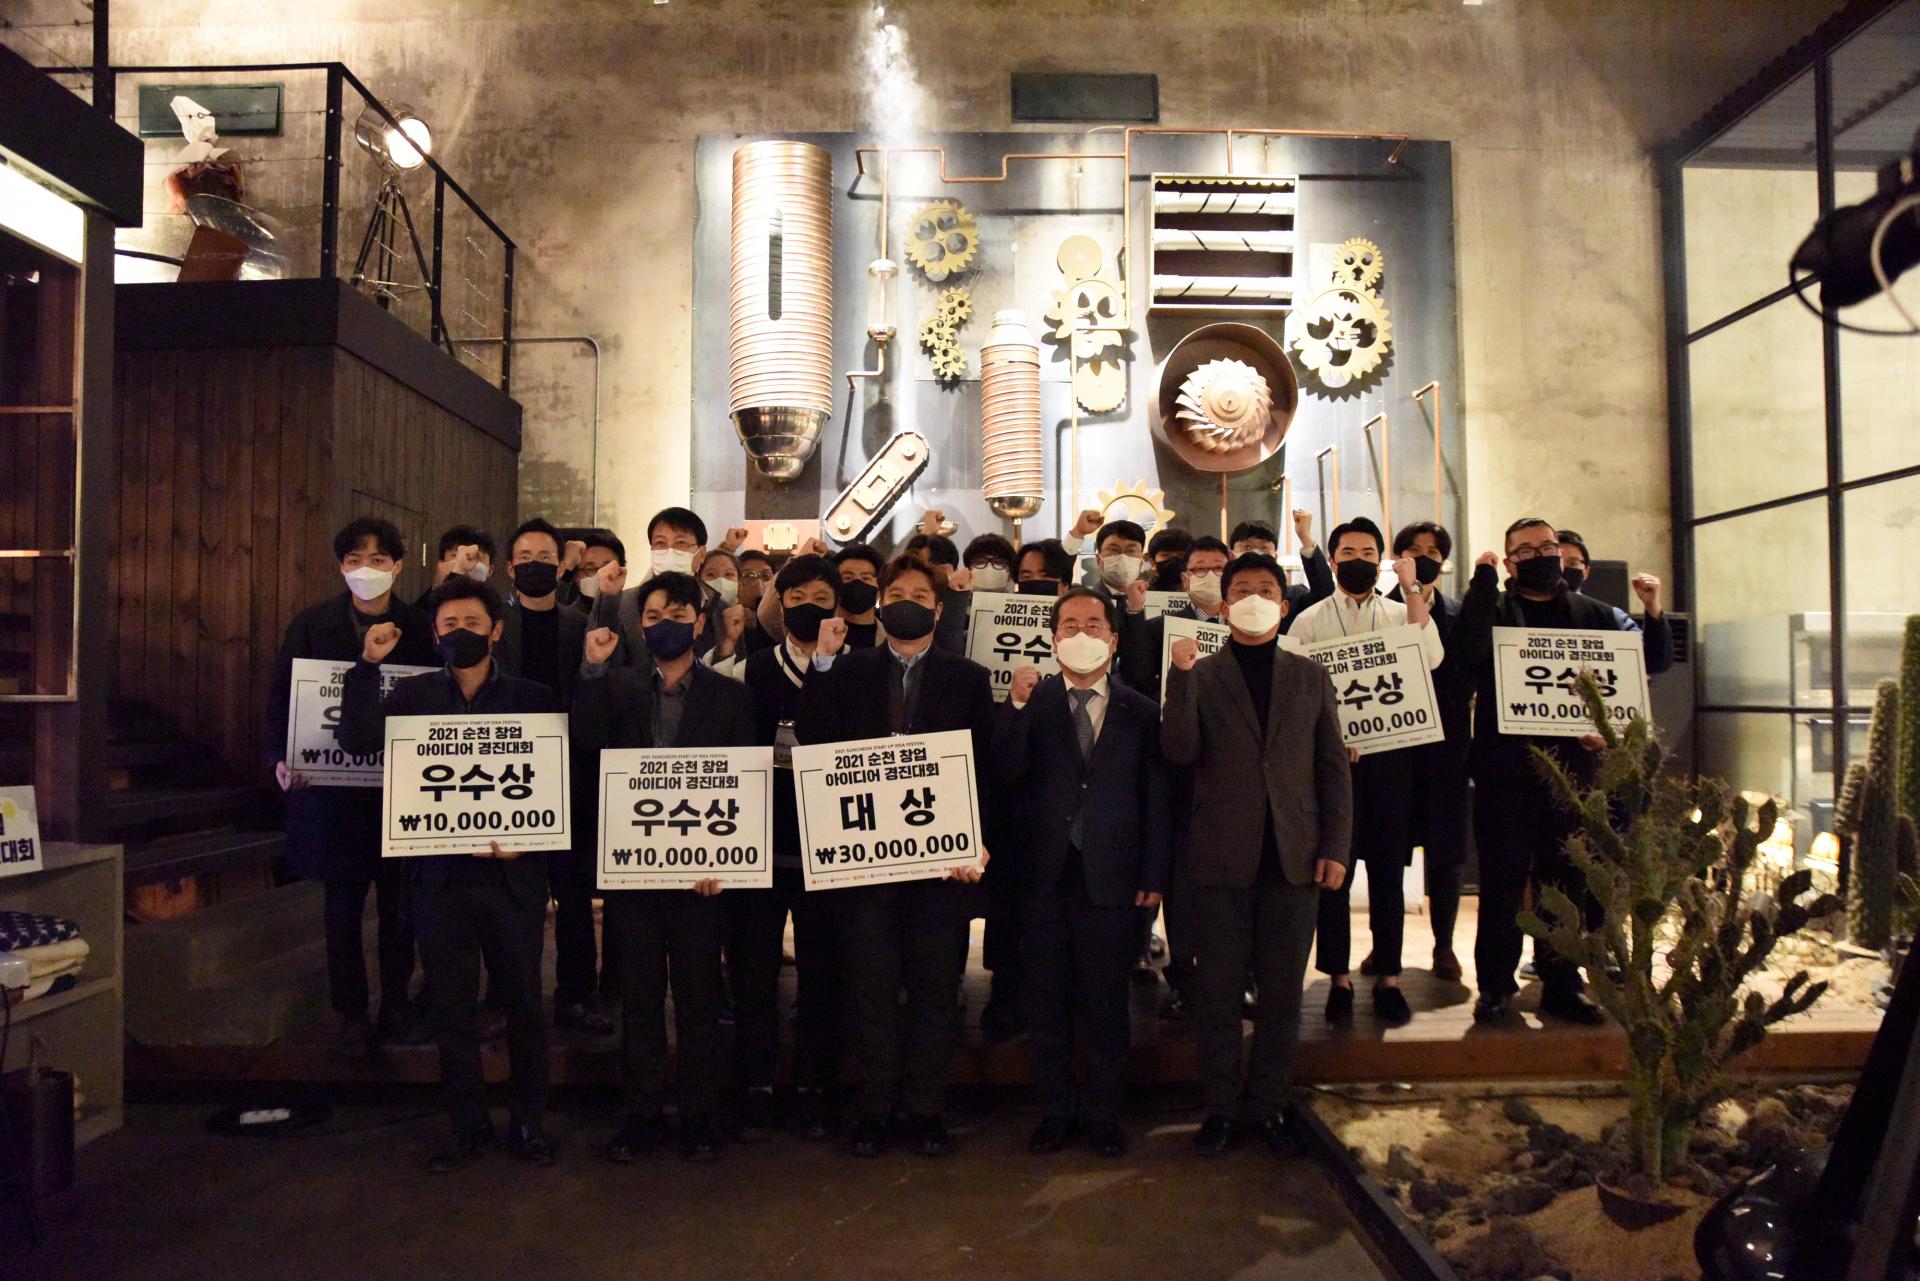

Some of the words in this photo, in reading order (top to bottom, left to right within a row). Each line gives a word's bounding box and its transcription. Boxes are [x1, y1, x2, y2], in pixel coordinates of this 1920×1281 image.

[1004, 603, 1027, 616] 2021
[994, 615, 1038, 628] 아이디어
[993, 632, 1052, 665] 우수
[1196, 630, 1218, 644] 2021
[1528, 637, 1552, 648] 2021
[1555, 638, 1578, 649] 순천
[1581, 639, 1604, 650] 창업
[1310, 651, 1334, 664] 2021
[1337, 648, 1360, 661] 순천
[1362, 641, 1386, 656] 창업
[1327, 662, 1349, 676] 디어
[1352, 652, 1398, 671] 경진대회
[1519, 649, 1565, 661] 아이디어
[1569, 651, 1615, 662] 경진대회
[1335, 672, 1404, 711] 수상
[428, 727, 458, 741] 2021
[462, 727, 490, 740] 순천
[494, 726, 522, 739] 창업
[1343, 708, 1428, 740] ,000,000
[416, 742, 473, 756] 아이디어
[478, 741, 534, 755] 경진대회
[835, 753, 864, 769] 2021
[868, 750, 895, 766] 순천
[899, 747, 927, 764] 창업
[640, 761, 667, 775] 2021
[671, 761, 698, 774] 순천
[702, 760, 728, 774] 창업
[825, 768, 880, 787] 아이디어
[884, 762, 940, 781] 경진대회
[420, 763, 535, 802] 우수상
[629, 776, 681, 790] 아이디어
[685, 775, 739, 789] 경진대회
[399, 810, 556, 833] ₩10,000,000
[631, 799, 740, 837] 우수상
[0, 838, 35, 863] 대회
[612, 846, 758, 869] ₩10,000,000
[815, 832, 969, 865] ₩30,000,000
